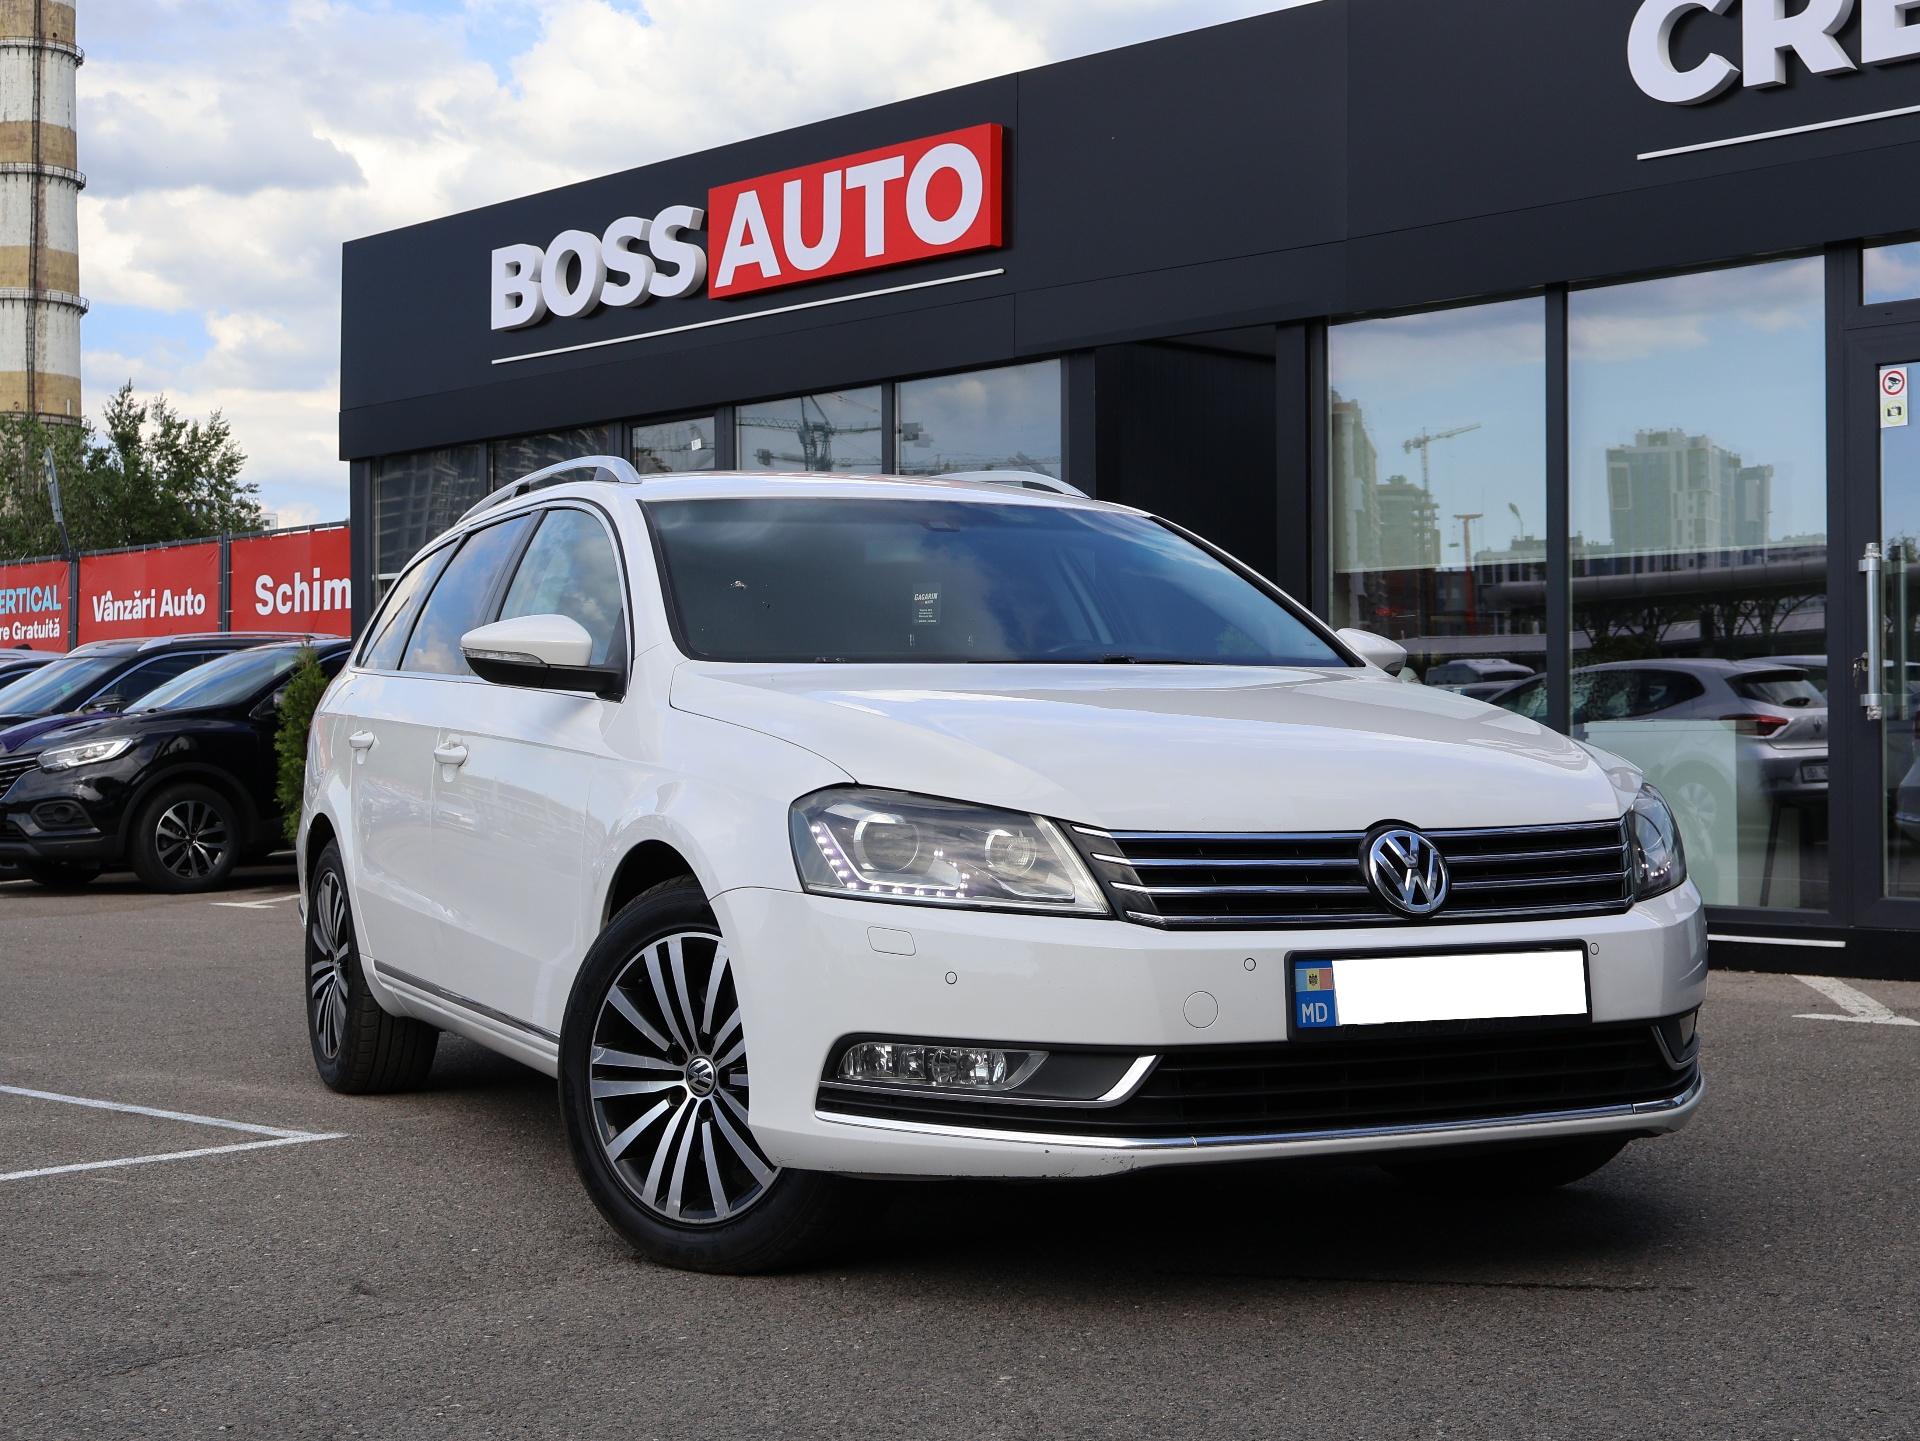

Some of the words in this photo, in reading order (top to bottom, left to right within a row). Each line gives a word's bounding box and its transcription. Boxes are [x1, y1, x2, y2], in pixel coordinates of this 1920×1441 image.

[491, 204, 707, 330] BOSS
[714, 142, 983, 289] AUTO
[92, 588, 156, 622] Vânzări
[159, 587, 206, 618] Auto
[255, 566, 352, 616] Schim
[12, 617, 60, 640] Gratuită
[1302, 1002, 1328, 1023] MD
